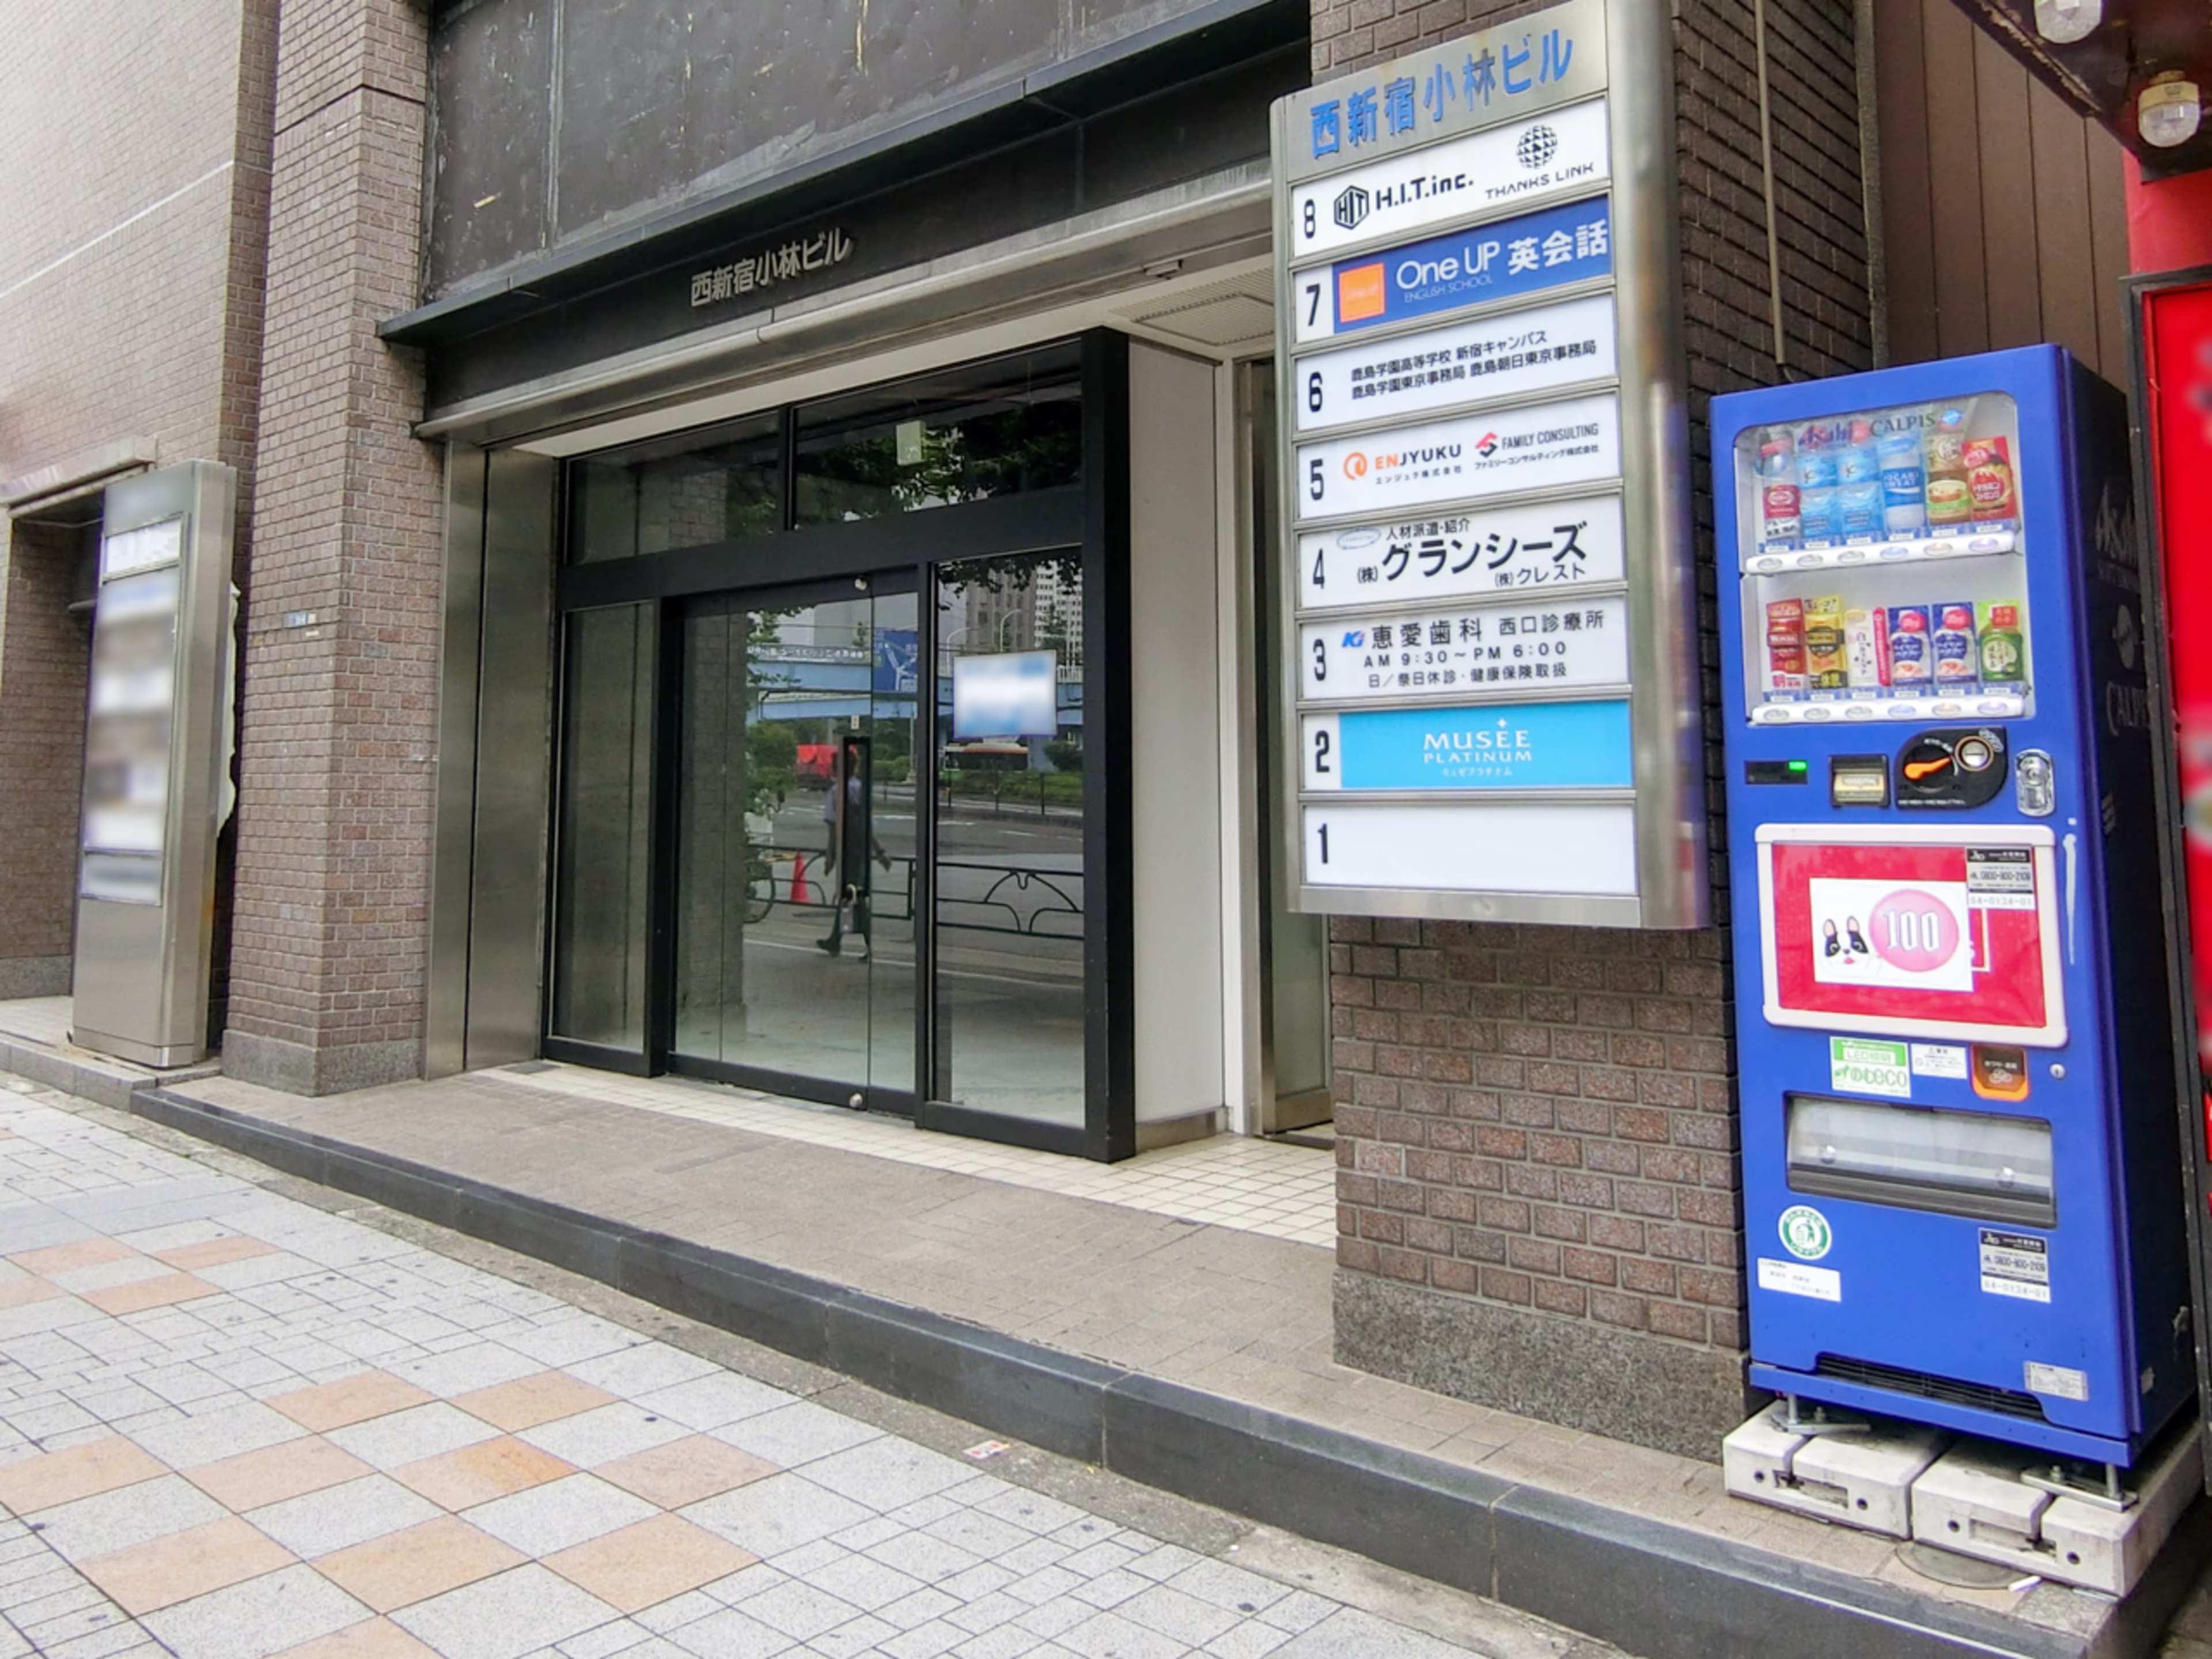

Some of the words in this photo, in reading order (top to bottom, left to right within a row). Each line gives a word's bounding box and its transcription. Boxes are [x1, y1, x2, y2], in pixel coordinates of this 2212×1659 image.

[1310, 28, 1573, 160] 西新宿小林ビル
[1376, 173, 1474, 210] H.I.T.inc.
[1486, 173, 1550, 200] THANKS
[1556, 162, 1594, 183] LINK
[1304, 199, 1316, 238] 8
[691, 227, 853, 307] 西新宿小林ビル
[1396, 257, 1459, 289] One
[1464, 241, 1500, 274] UP
[1508, 219, 1608, 275] 英会話
[1305, 283, 1321, 326] 7
[1404, 286, 1446, 303] ENGLISH
[1448, 274, 1493, 293] SCHOOL
[1351, 350, 1452, 382] 鹿島学園高等学校
[1456, 331, 1548, 361] 新宿キャンパス
[1308, 372, 1323, 412] 6
[1502, 433, 1535, 450] FAMILY
[1537, 422, 1599, 446] CONSULTING
[1871, 413, 1936, 437] CALPIS
[1375, 444, 1463, 470] ENJYUKU
[1310, 459, 1325, 500] 5
[1312, 548, 1325, 589] 4
[1372, 617, 1482, 649] 恵愛歯科
[1499, 609, 1604, 636] 西口診療所
[1313, 639, 1326, 681] 3
[1315, 730, 1330, 772] 2
[1423, 751, 1532, 764] PLATINUM
[1317, 823, 1328, 864] 1
[1884, 910, 1941, 952] 100
